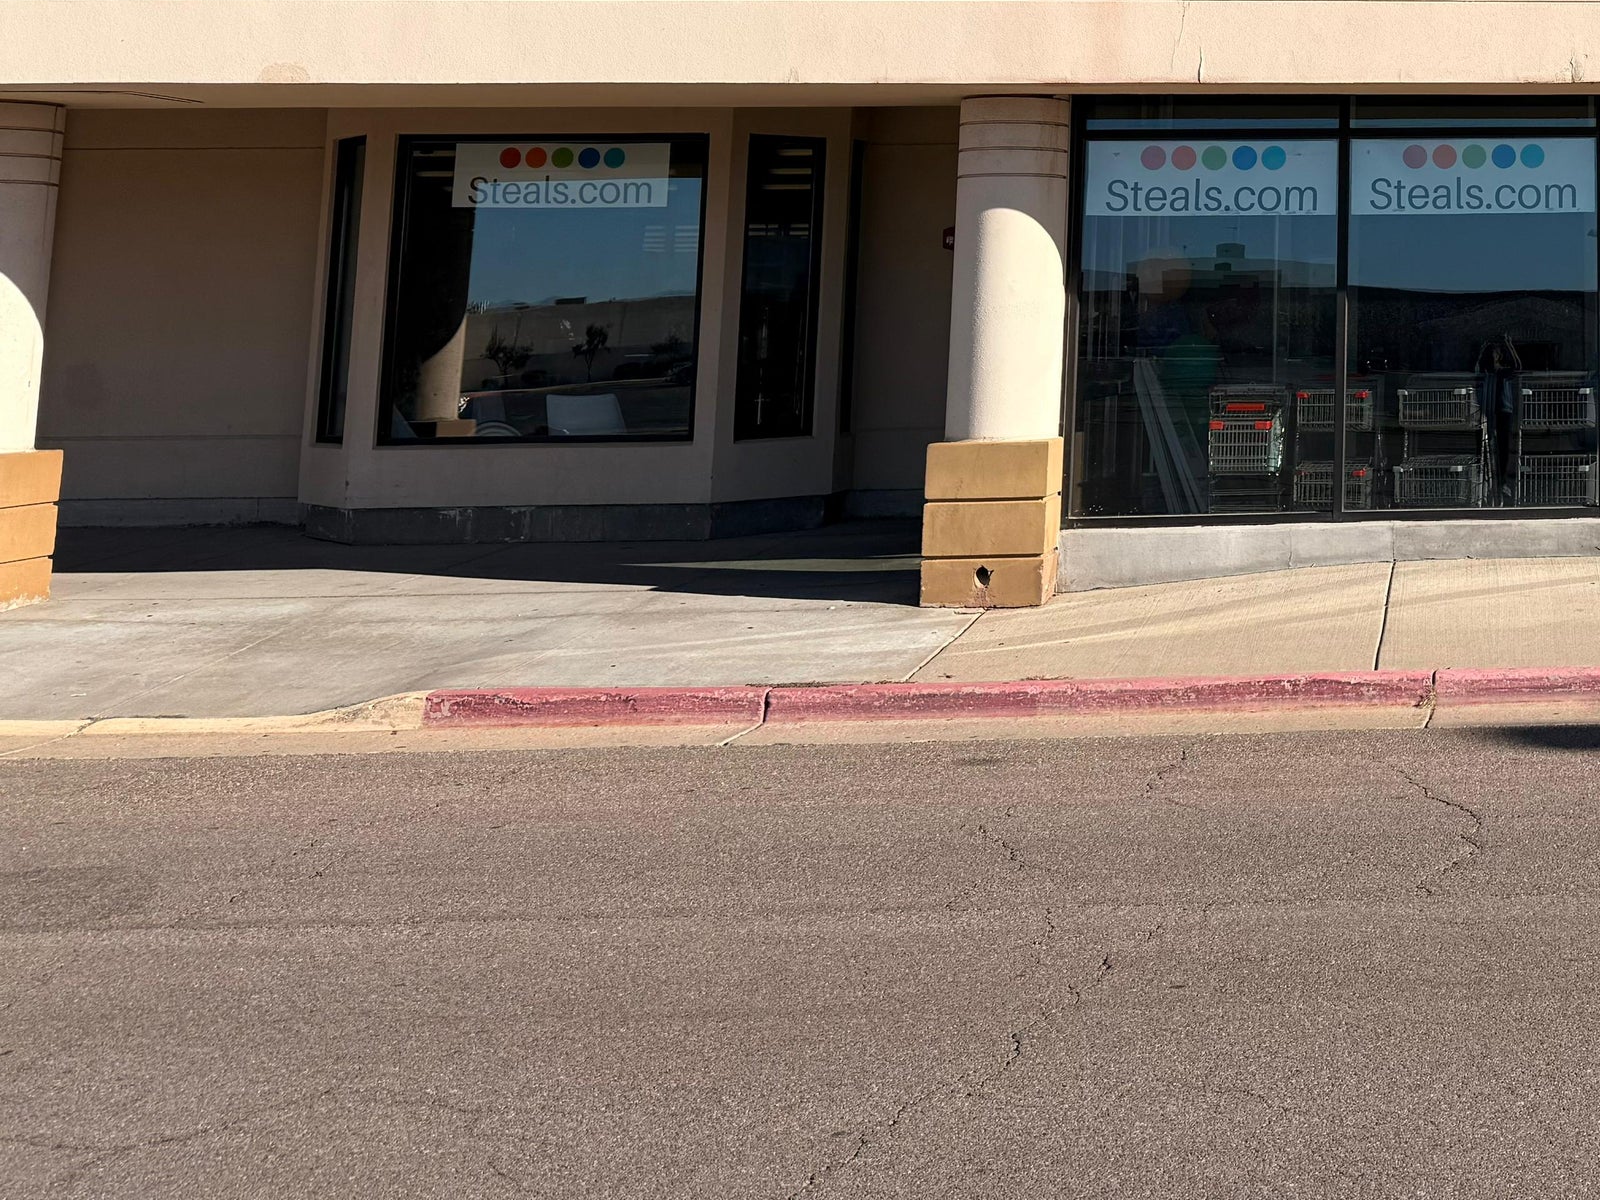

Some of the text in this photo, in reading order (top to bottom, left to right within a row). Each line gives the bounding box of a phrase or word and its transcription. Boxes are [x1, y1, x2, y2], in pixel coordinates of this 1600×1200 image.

[468, 174, 653, 207] Steals.com
[1105, 177, 1319, 215] Steals.com
[1369, 175, 1578, 211] Steals.com
